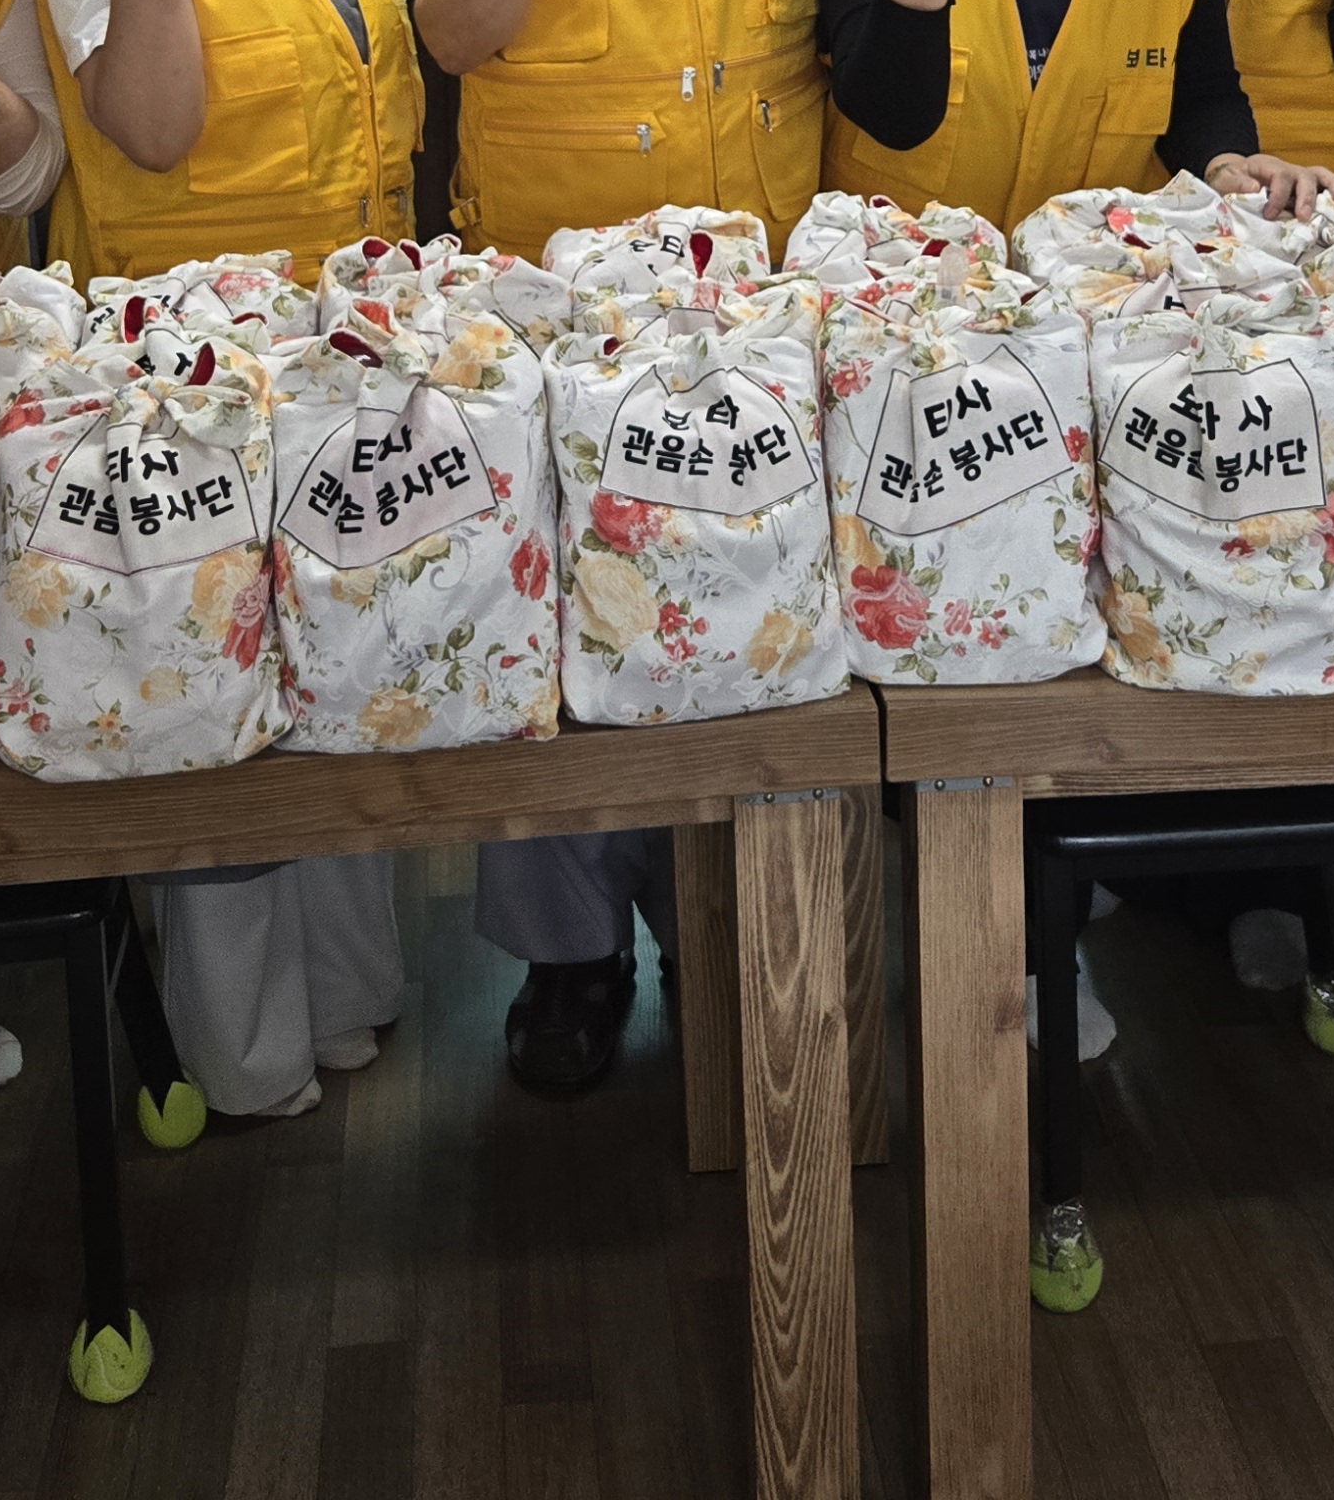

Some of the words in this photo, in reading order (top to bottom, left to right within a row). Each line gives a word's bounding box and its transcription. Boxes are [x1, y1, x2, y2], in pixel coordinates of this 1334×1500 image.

[1126, 47, 1174, 68] 보타
[622, 424, 714, 476] 관음손
[949, 409, 1048, 482] 봉사단
[1215, 438, 1308, 493] 봉사단
[59, 483, 120, 537] 관음
[129, 475, 235, 537] 봉사단
[376, 446, 471, 527] 봉사단
